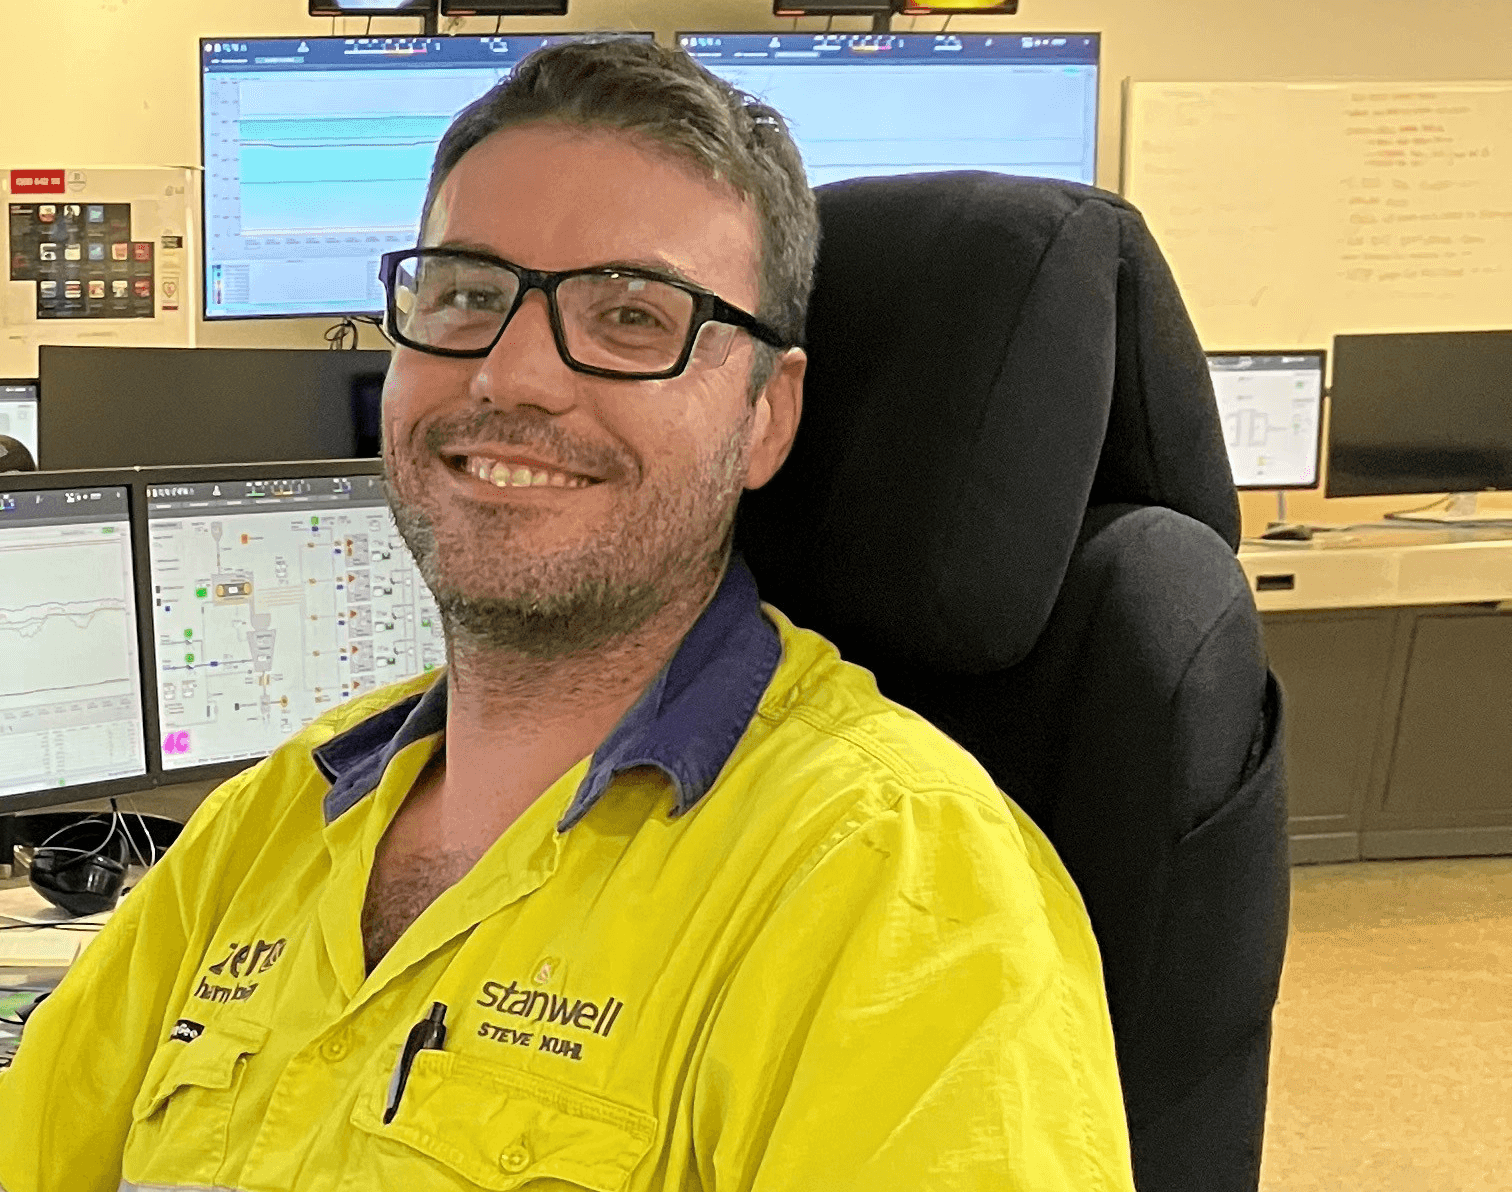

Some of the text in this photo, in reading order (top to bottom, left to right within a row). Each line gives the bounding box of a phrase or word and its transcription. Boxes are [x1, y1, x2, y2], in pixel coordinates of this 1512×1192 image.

[476, 980, 624, 1037] stanwell
[477, 1021, 583, 1061] STEVE KUHL
